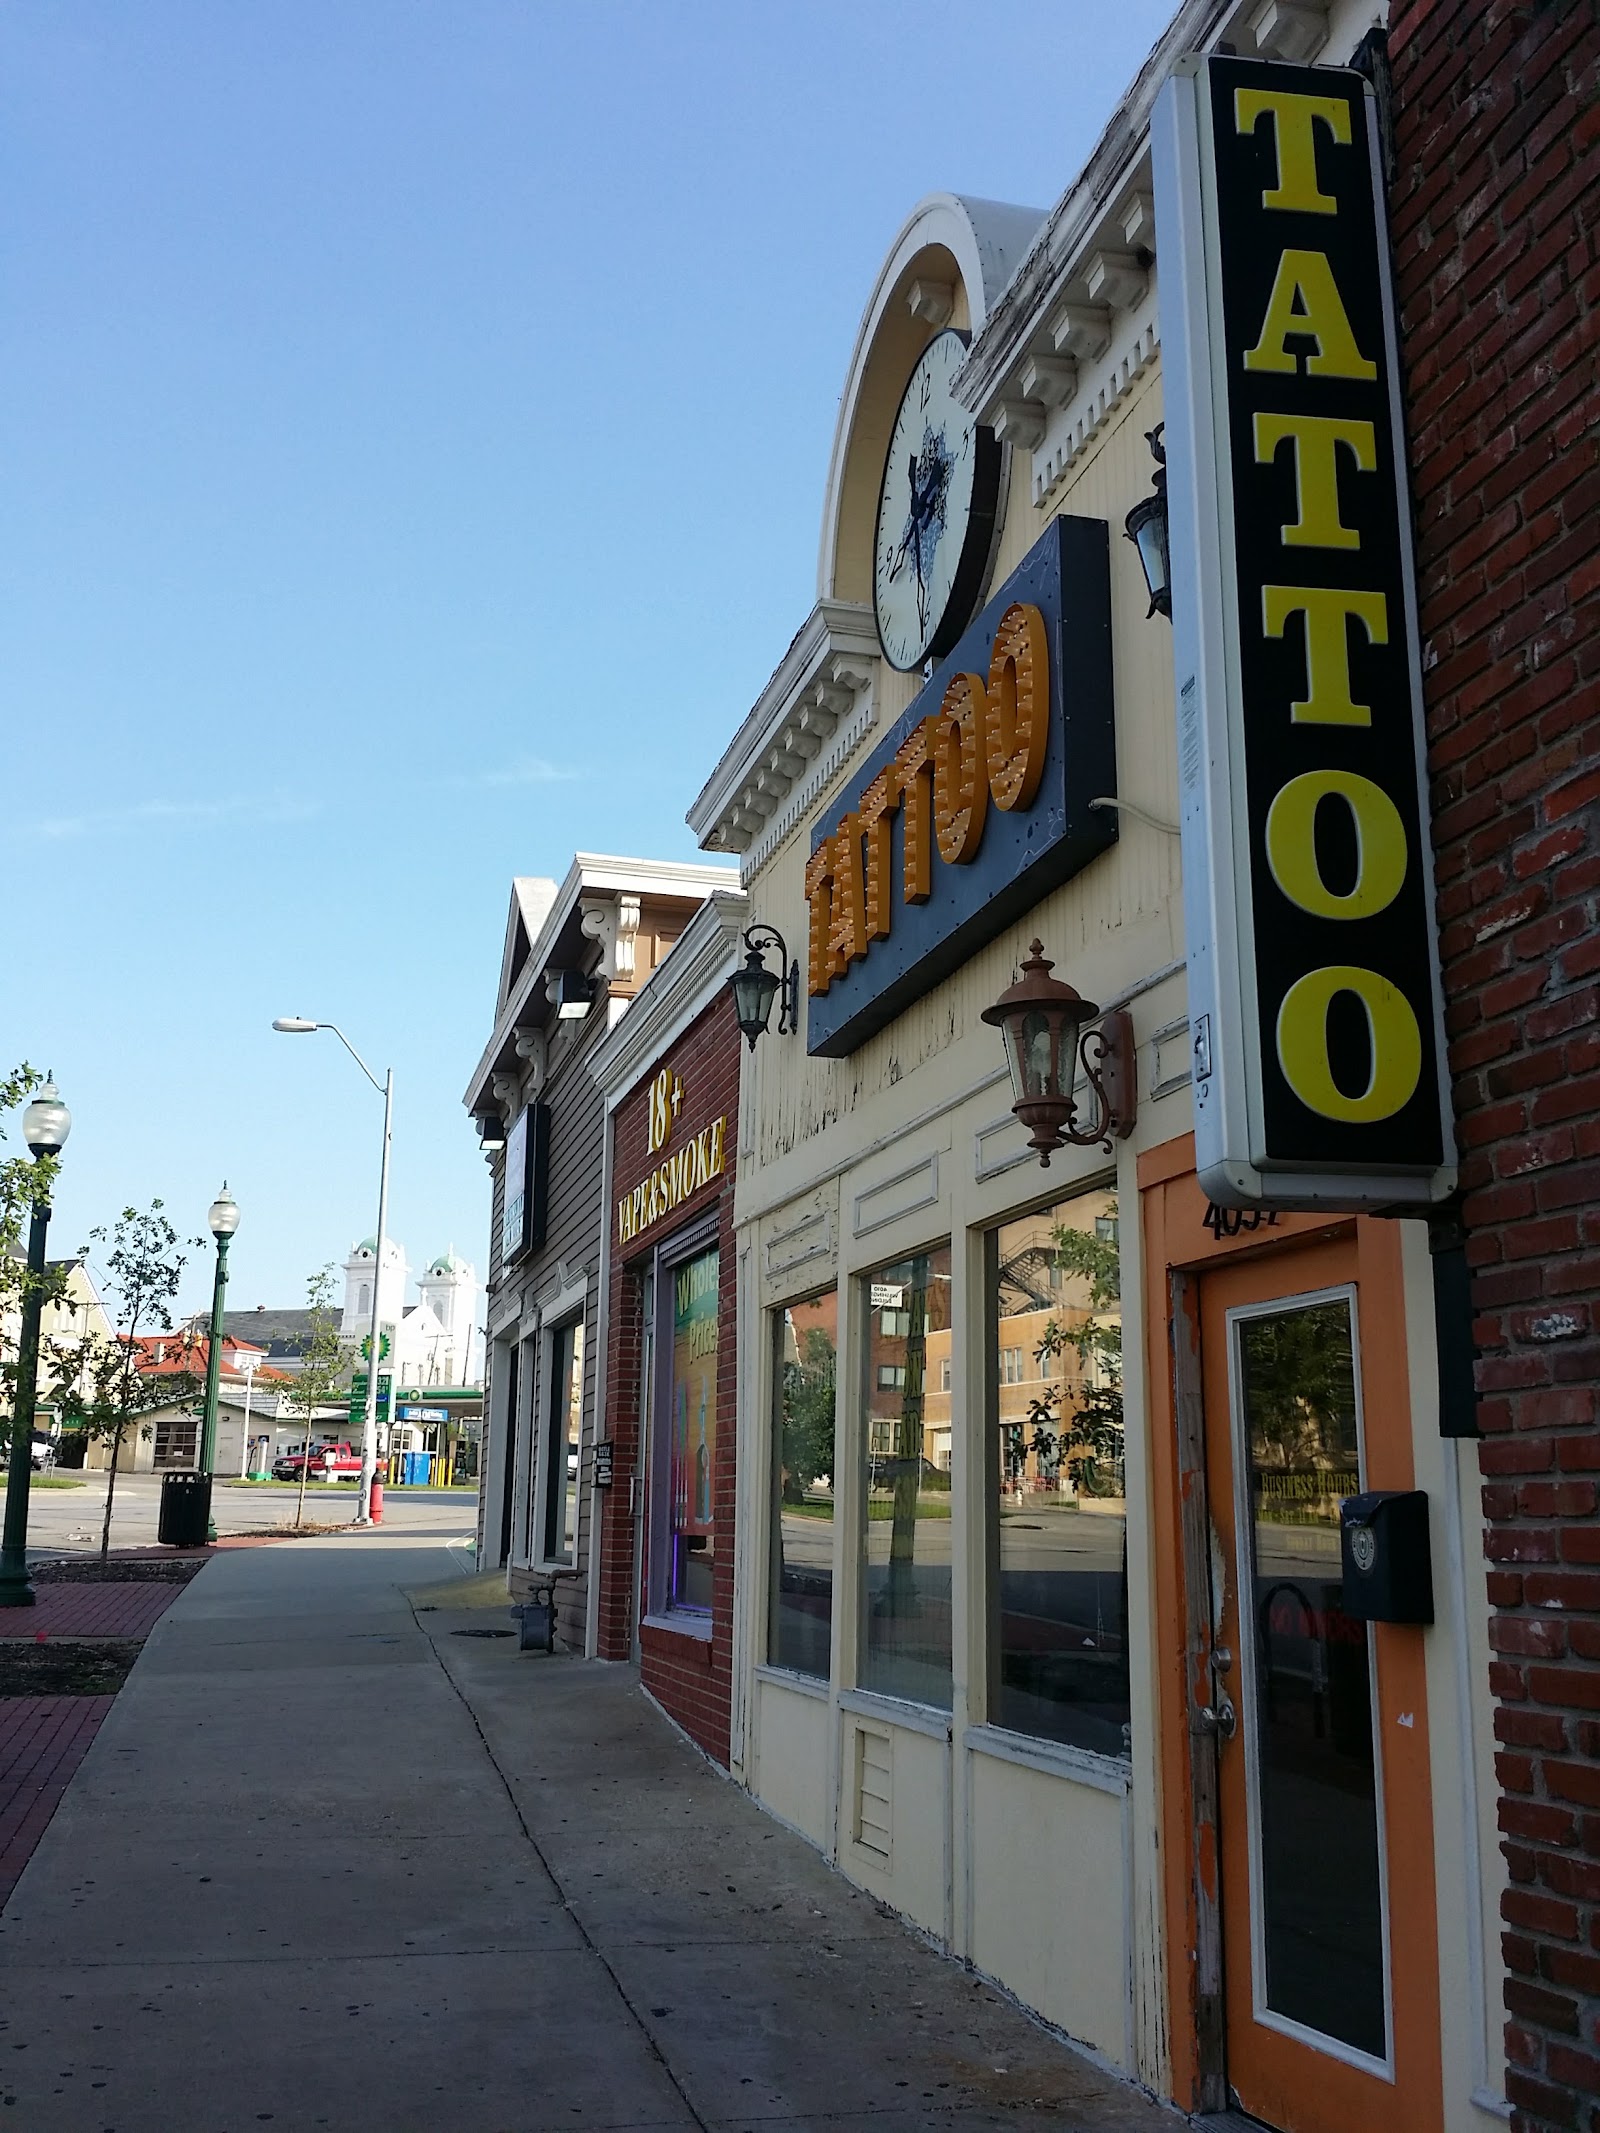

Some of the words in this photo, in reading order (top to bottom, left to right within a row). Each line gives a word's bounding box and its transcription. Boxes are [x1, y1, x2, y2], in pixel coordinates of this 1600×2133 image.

[1235, 87, 1421, 1124] TATTOO
[805, 602, 1049, 997] TATTOO
[646, 1068, 684, 1156] 18+
[690, 1312, 718, 1364] Price
[1261, 1472, 1313, 1499] BUSINESS
